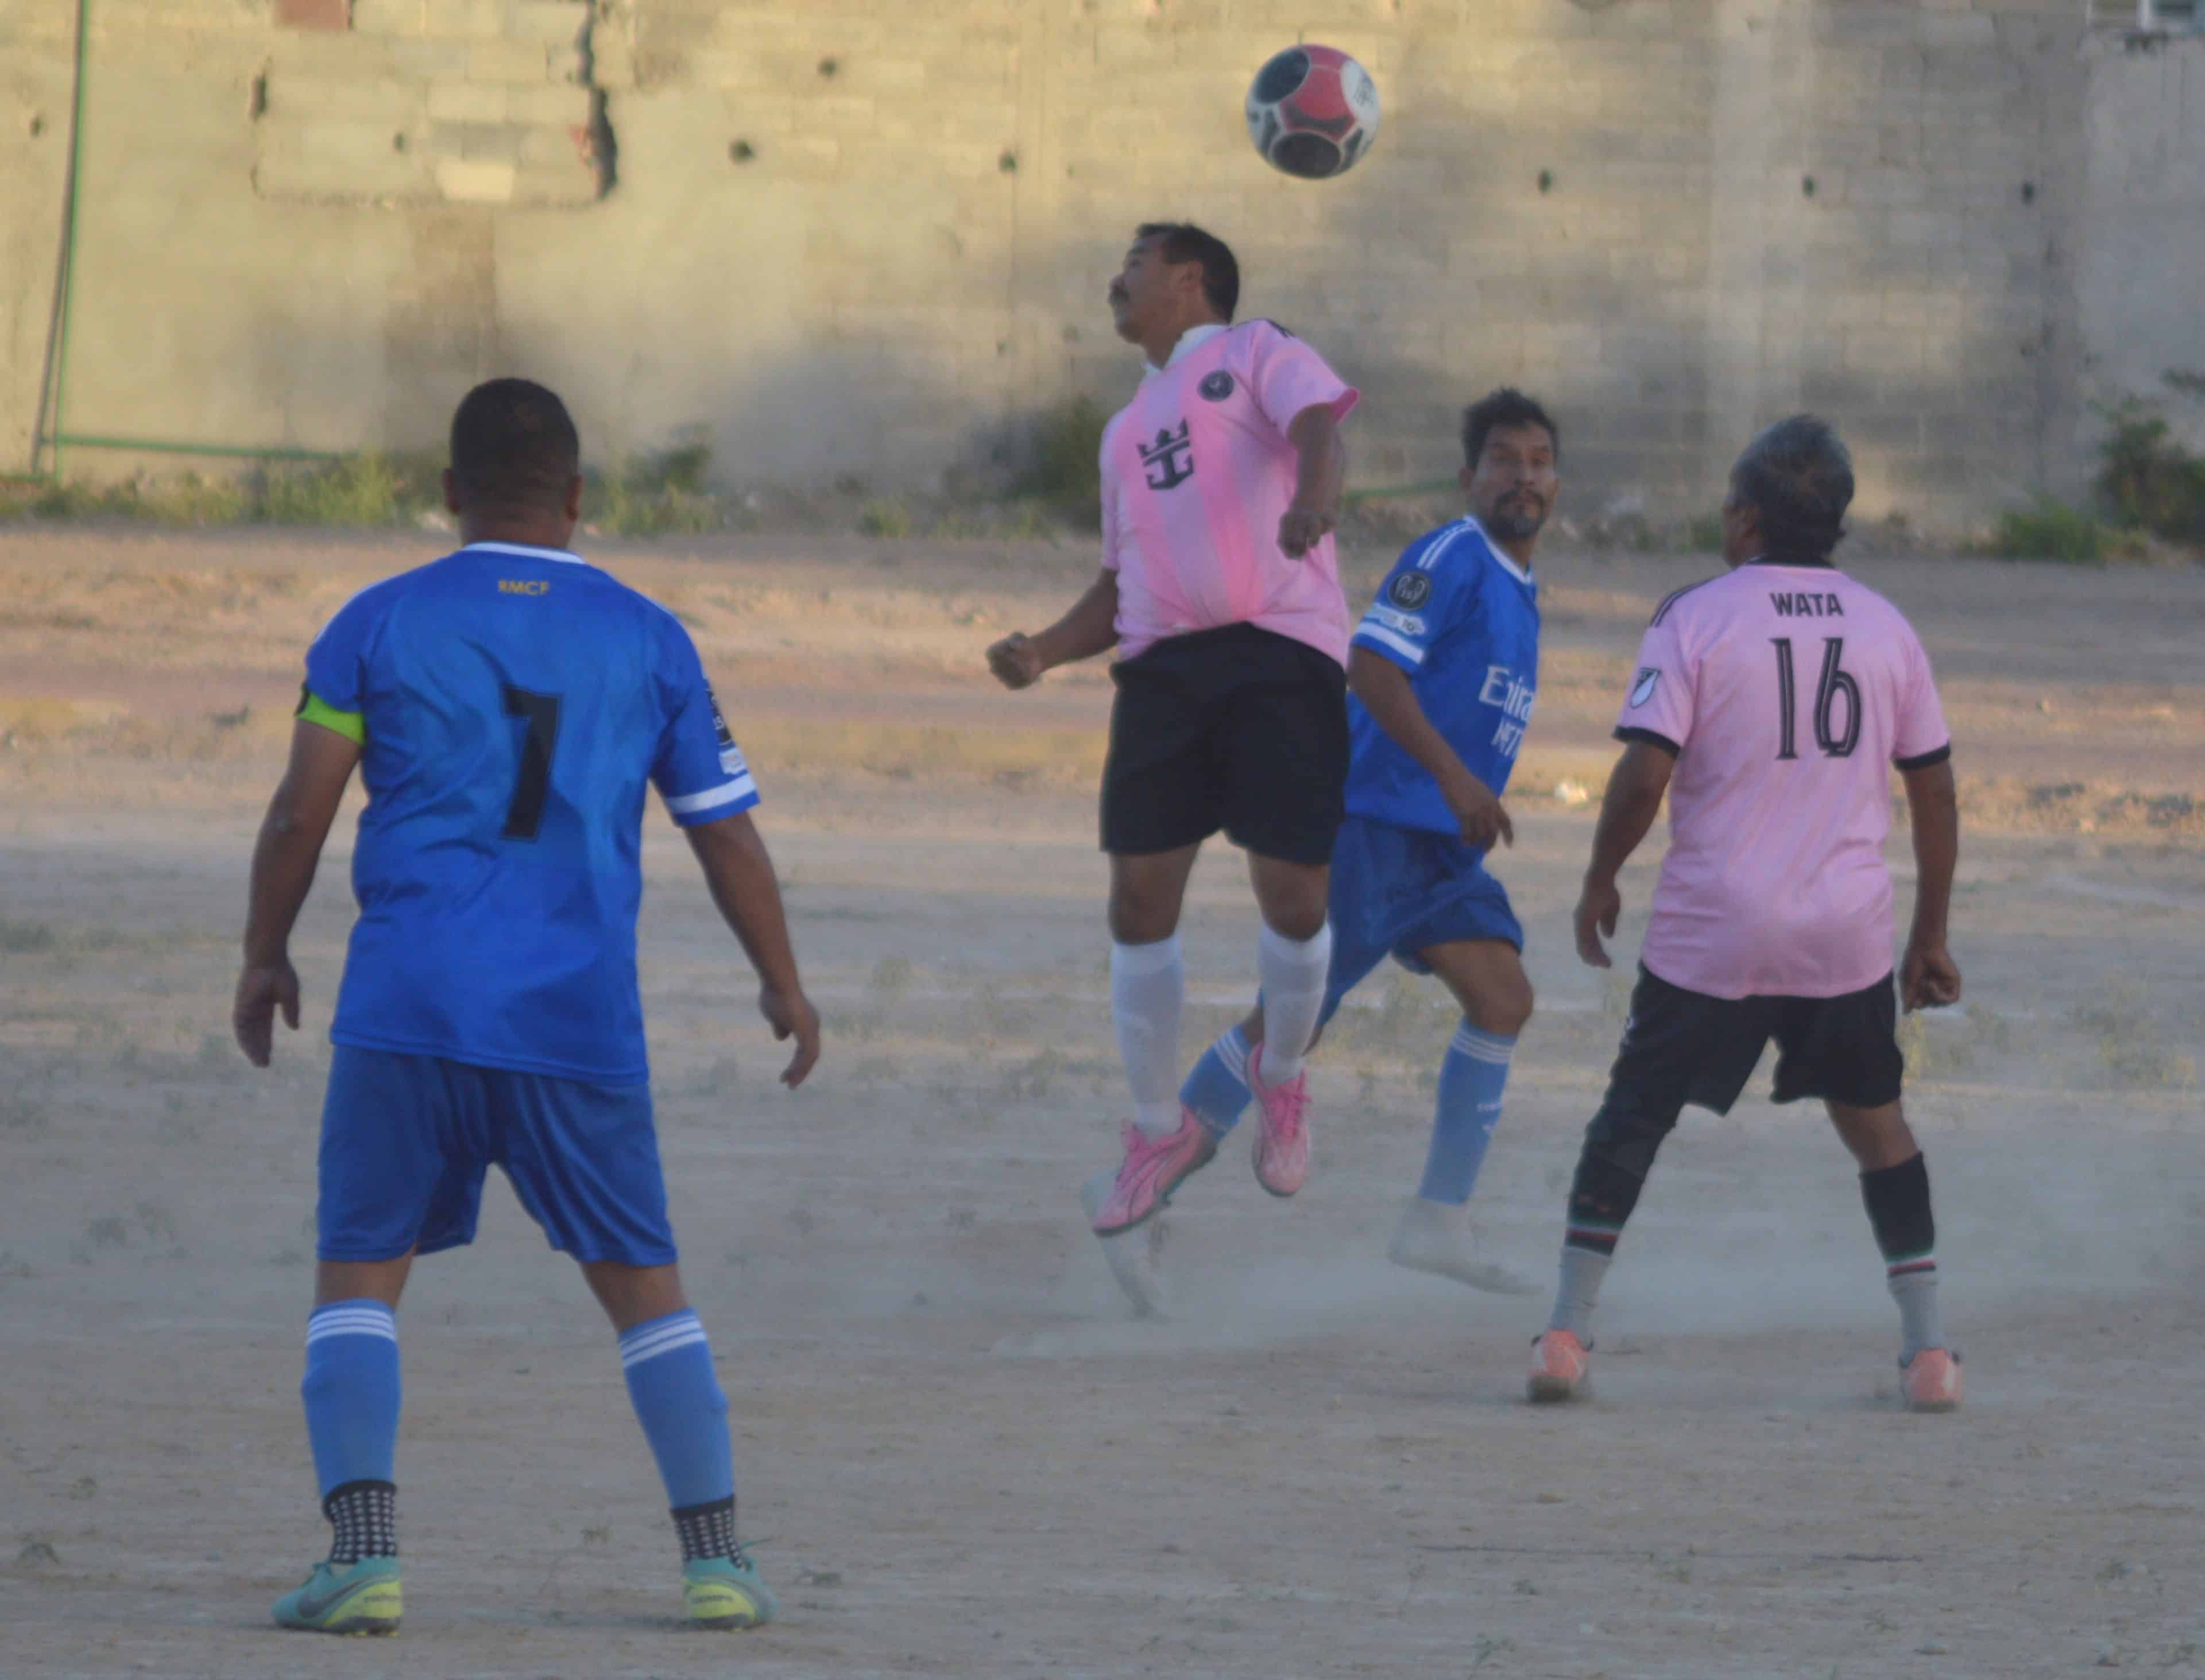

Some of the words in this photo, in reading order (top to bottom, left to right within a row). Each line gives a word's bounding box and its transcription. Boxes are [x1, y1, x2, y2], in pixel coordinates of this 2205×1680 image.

[1769, 593, 1844, 617] WATA
[1767, 637, 1862, 760] 16
[498, 683, 563, 842] 7
